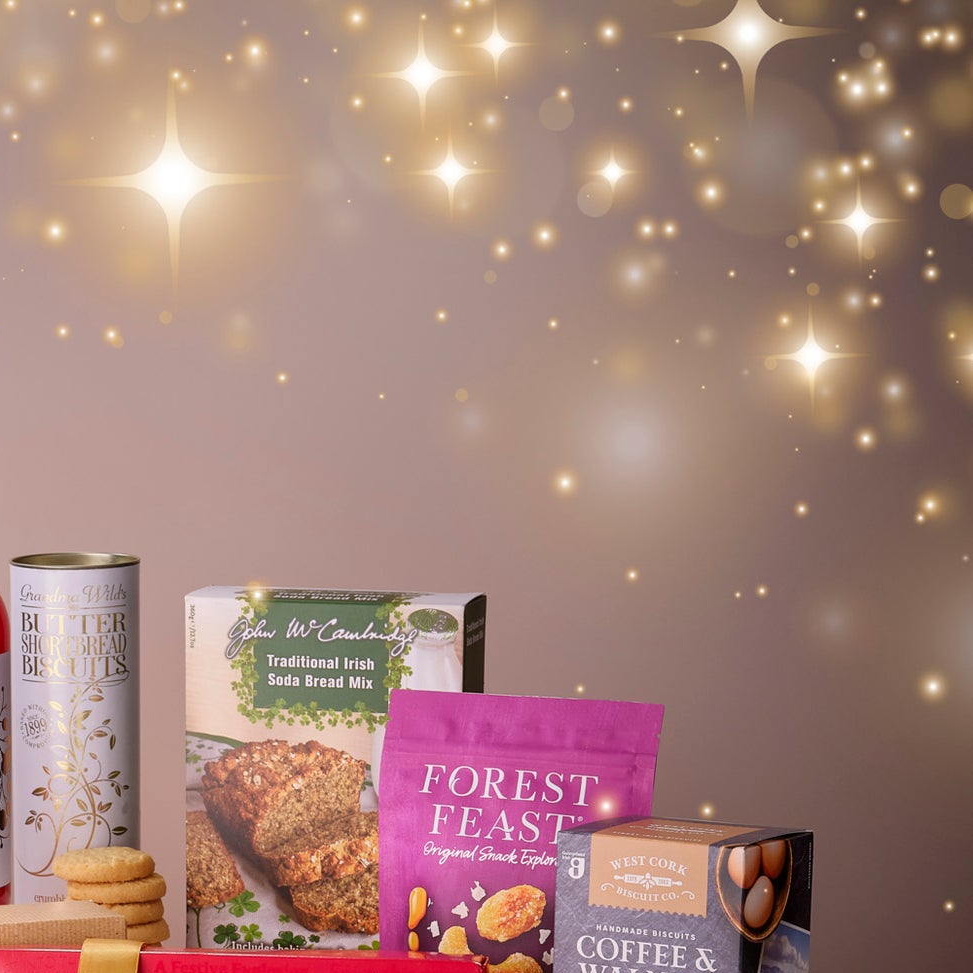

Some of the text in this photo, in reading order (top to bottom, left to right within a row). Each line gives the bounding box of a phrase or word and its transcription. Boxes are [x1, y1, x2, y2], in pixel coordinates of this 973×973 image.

[20, 584, 126, 603] Grandma Wild's
[21, 612, 126, 635] BUTTER
[21, 633, 127, 656] SHORTBREAD
[225, 617, 276, 659] John
[22, 654, 127, 678] BISCUITS
[267, 653, 375, 671] Traditional Irish
[267, 673, 374, 690] Soda Bread Mix
[24, 718, 47, 737] 1899
[419, 764, 599, 807] FOREST
[429, 804, 575, 845] FEAST
[423, 840, 557, 870] Original Snack Explor
[611, 855, 689, 876] WEST CORK
[616, 885, 659, 902] BISCUIT
[595, 923, 697, 941] HANDMADE BISCUITS
[577, 935, 718, 973] COFFEE &
